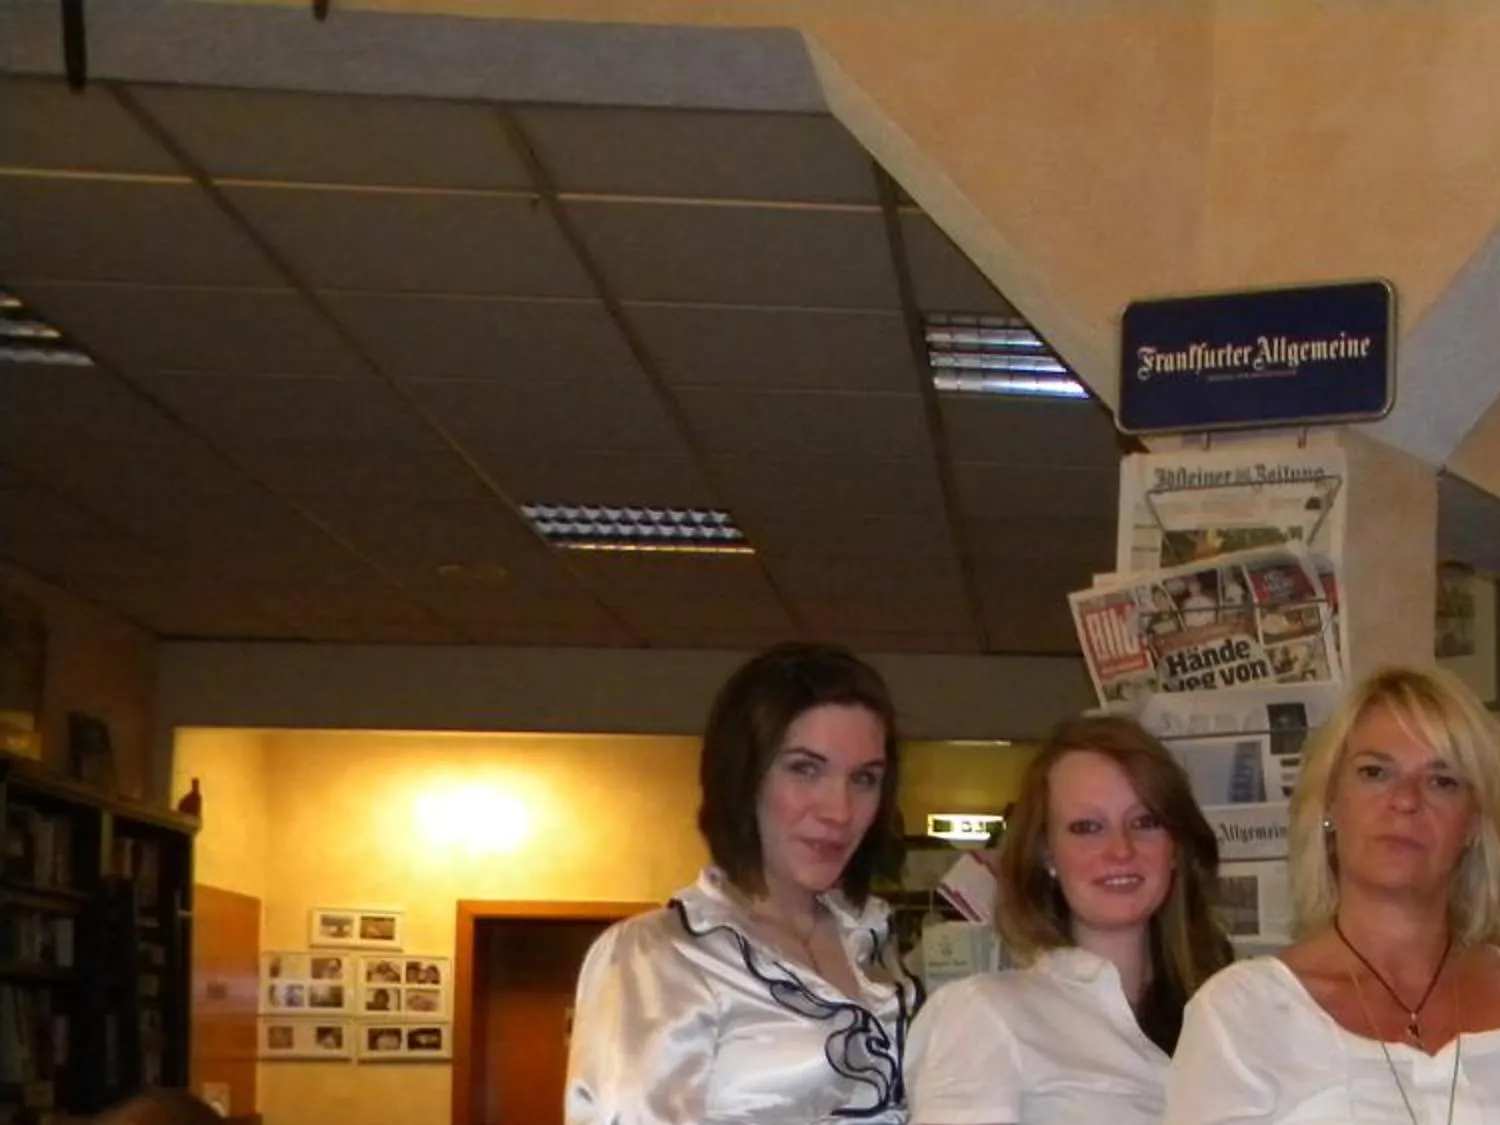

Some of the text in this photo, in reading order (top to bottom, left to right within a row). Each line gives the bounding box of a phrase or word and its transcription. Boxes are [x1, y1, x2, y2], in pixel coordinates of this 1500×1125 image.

[1137, 331, 1371, 381] Frankfurter Allgemeine
[1165, 638, 1251, 677] Hände
[1220, 659, 1268, 686] von
[1219, 822, 1288, 843] Allgemein
